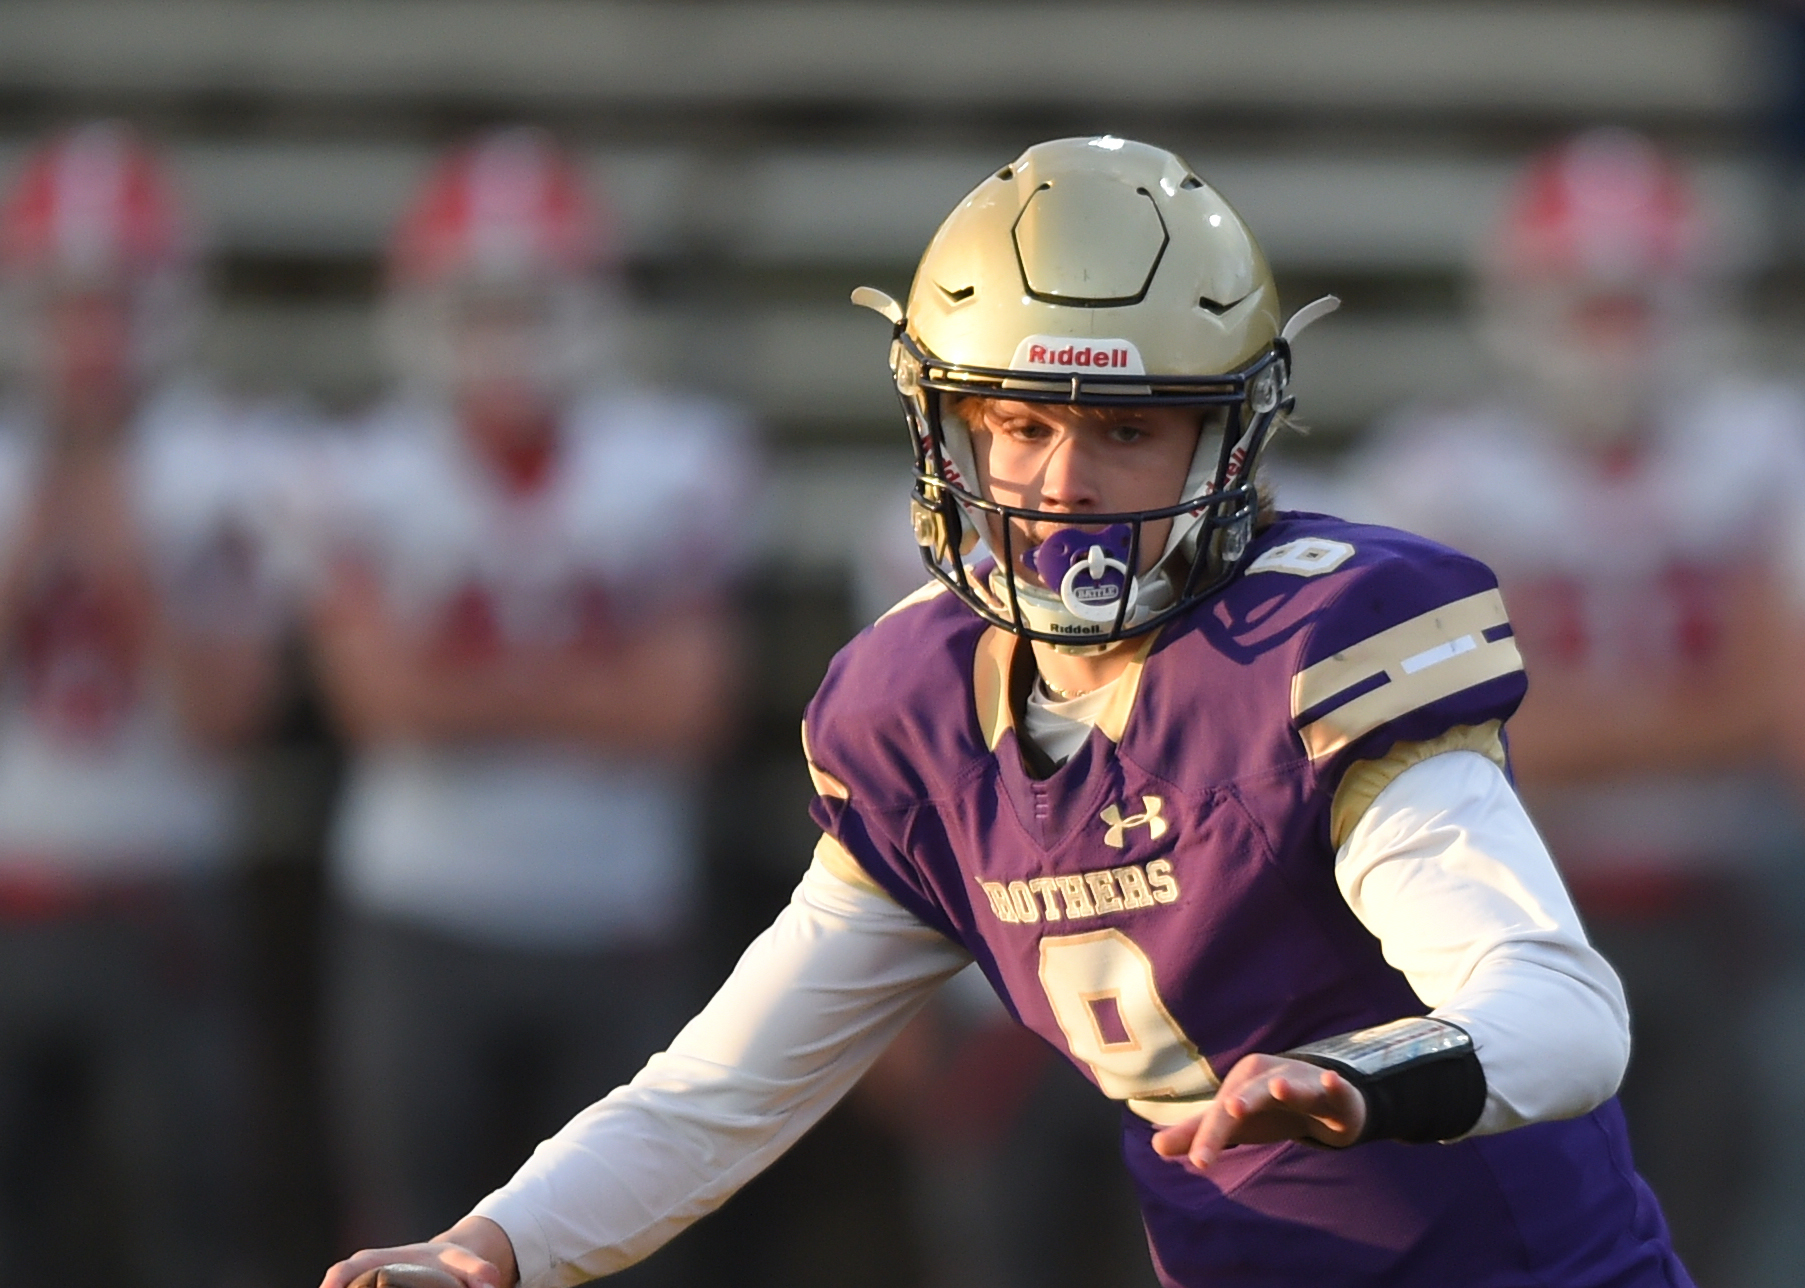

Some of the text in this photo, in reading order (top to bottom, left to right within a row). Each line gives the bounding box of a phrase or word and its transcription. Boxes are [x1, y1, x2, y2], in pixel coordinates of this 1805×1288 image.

[1028, 344, 1128, 368] Riddell
[1077, 586, 1116, 599] BATTLE
[1050, 623, 1101, 635] Riddell
[975, 858, 1180, 924] ROTHERS
